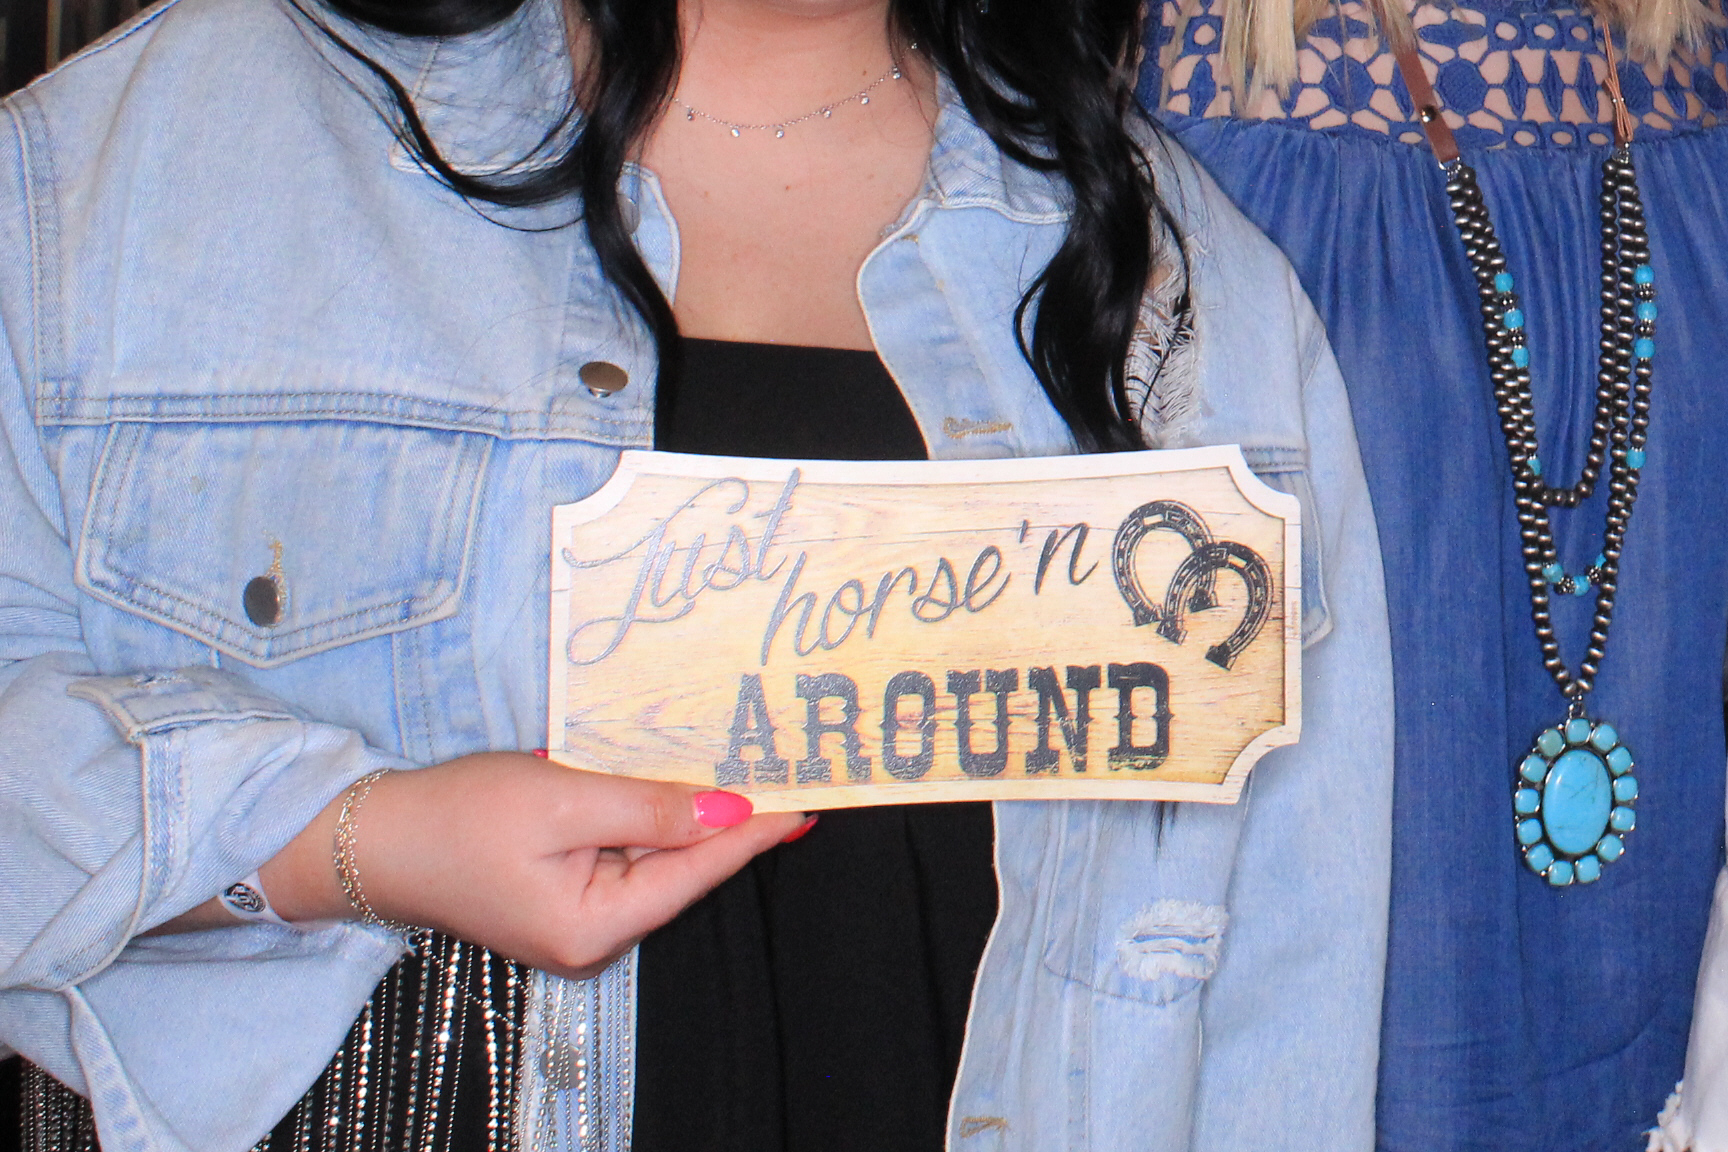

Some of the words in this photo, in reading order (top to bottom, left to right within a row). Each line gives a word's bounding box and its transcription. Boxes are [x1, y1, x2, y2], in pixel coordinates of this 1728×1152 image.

[560, 467, 801, 666] Just
[759, 518, 1100, 666] horse'n
[714, 661, 1175, 786] AROUND
